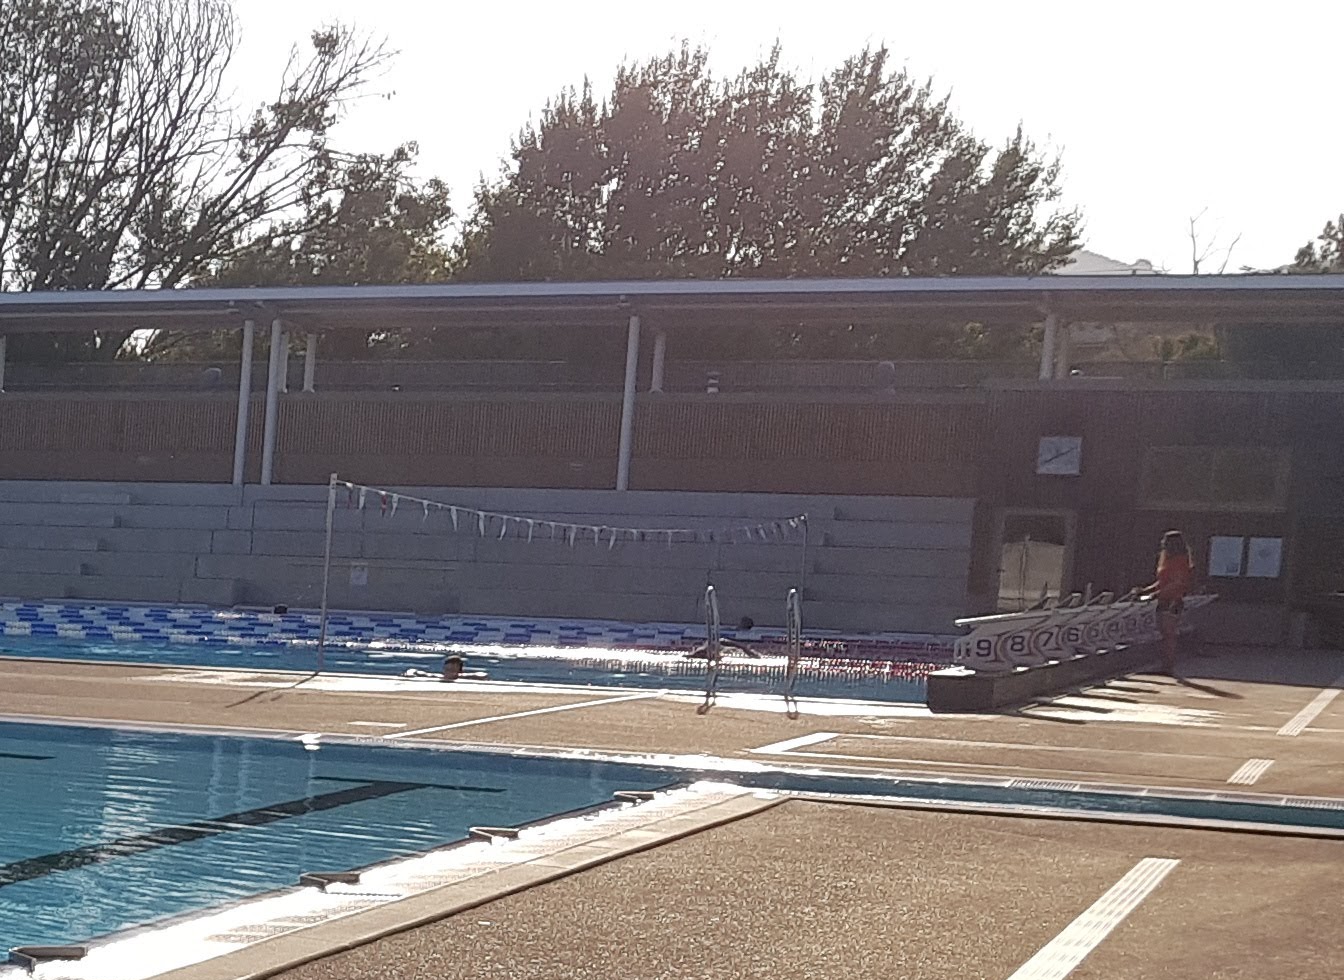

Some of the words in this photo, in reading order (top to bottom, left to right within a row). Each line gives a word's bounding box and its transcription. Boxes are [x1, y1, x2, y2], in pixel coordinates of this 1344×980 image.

[1037, 631, 1053, 647] 7
[1067, 627, 1079, 642] 6
[976, 639, 992, 658] 9
[1010, 635, 1025, 652] 8
